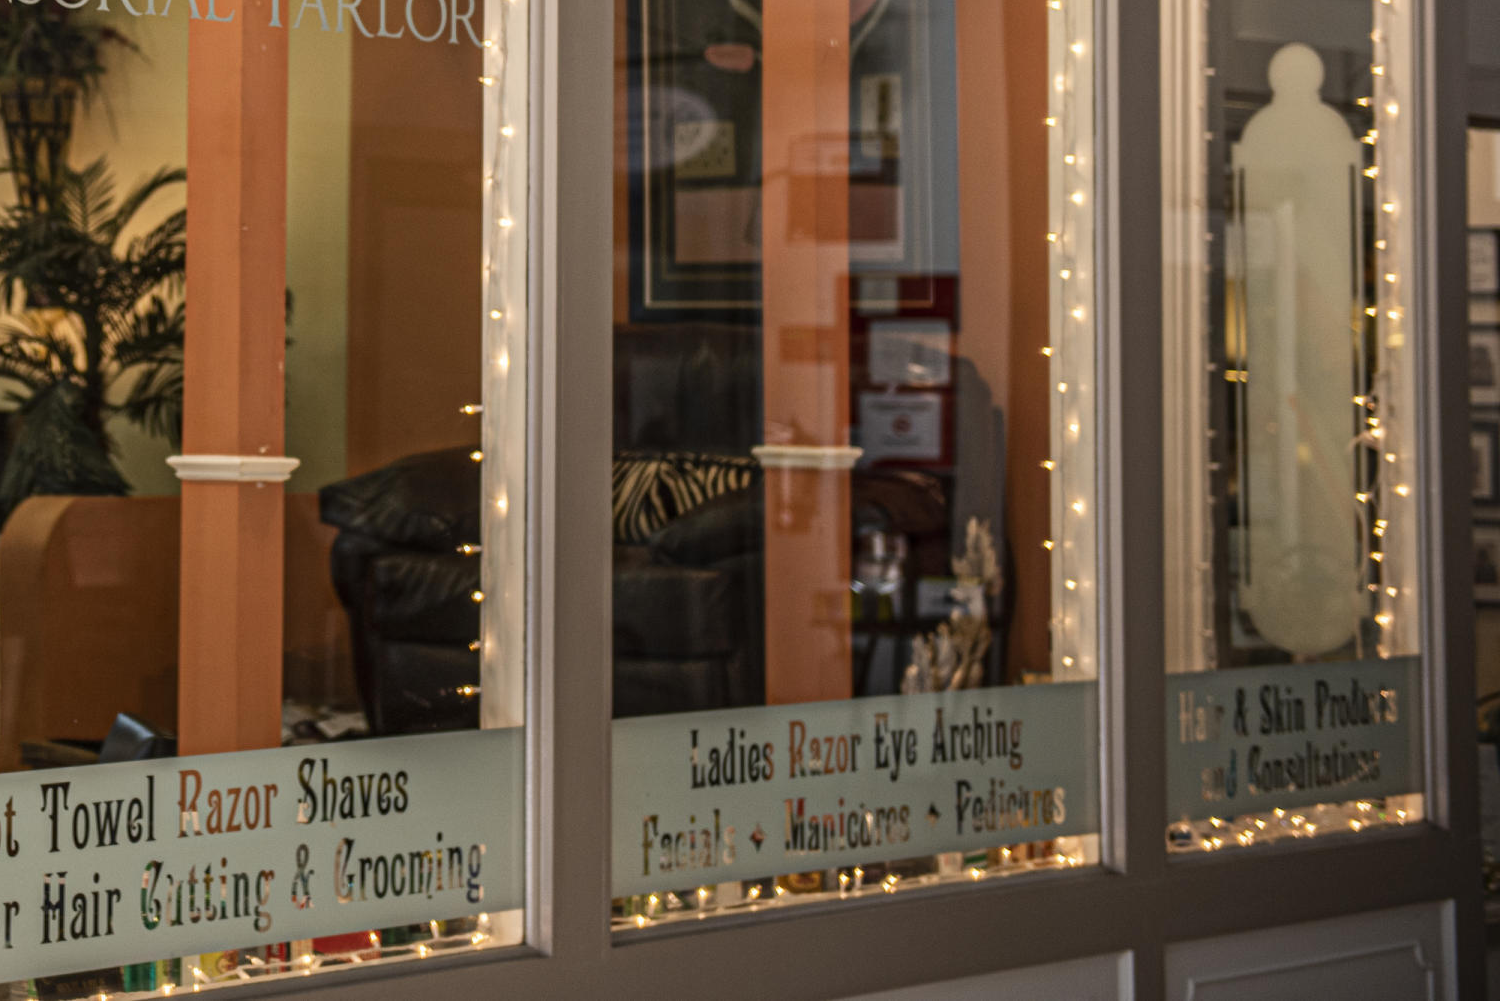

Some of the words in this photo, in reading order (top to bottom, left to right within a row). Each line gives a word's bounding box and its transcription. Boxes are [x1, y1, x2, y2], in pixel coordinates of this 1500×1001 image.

[689, 727, 774, 789] Ladies
[788, 719, 861, 779] Razor
[874, 712, 918, 783] Eye
[930, 706, 1024, 770] Arching
[1233, 687, 1249, 737] &
[1259, 684, 1306, 735] Skin
[41, 775, 156, 853] Towel
[178, 769, 279, 838] Razor
[297, 758, 410, 824] Shaves
[642, 808, 736, 876] Facials
[785, 797, 910, 855] Manicures
[42, 871, 122, 944] Hair
[140, 857, 274, 932] Cutting
[291, 844, 315, 909] &
[333, 831, 486, 904] Grooming
